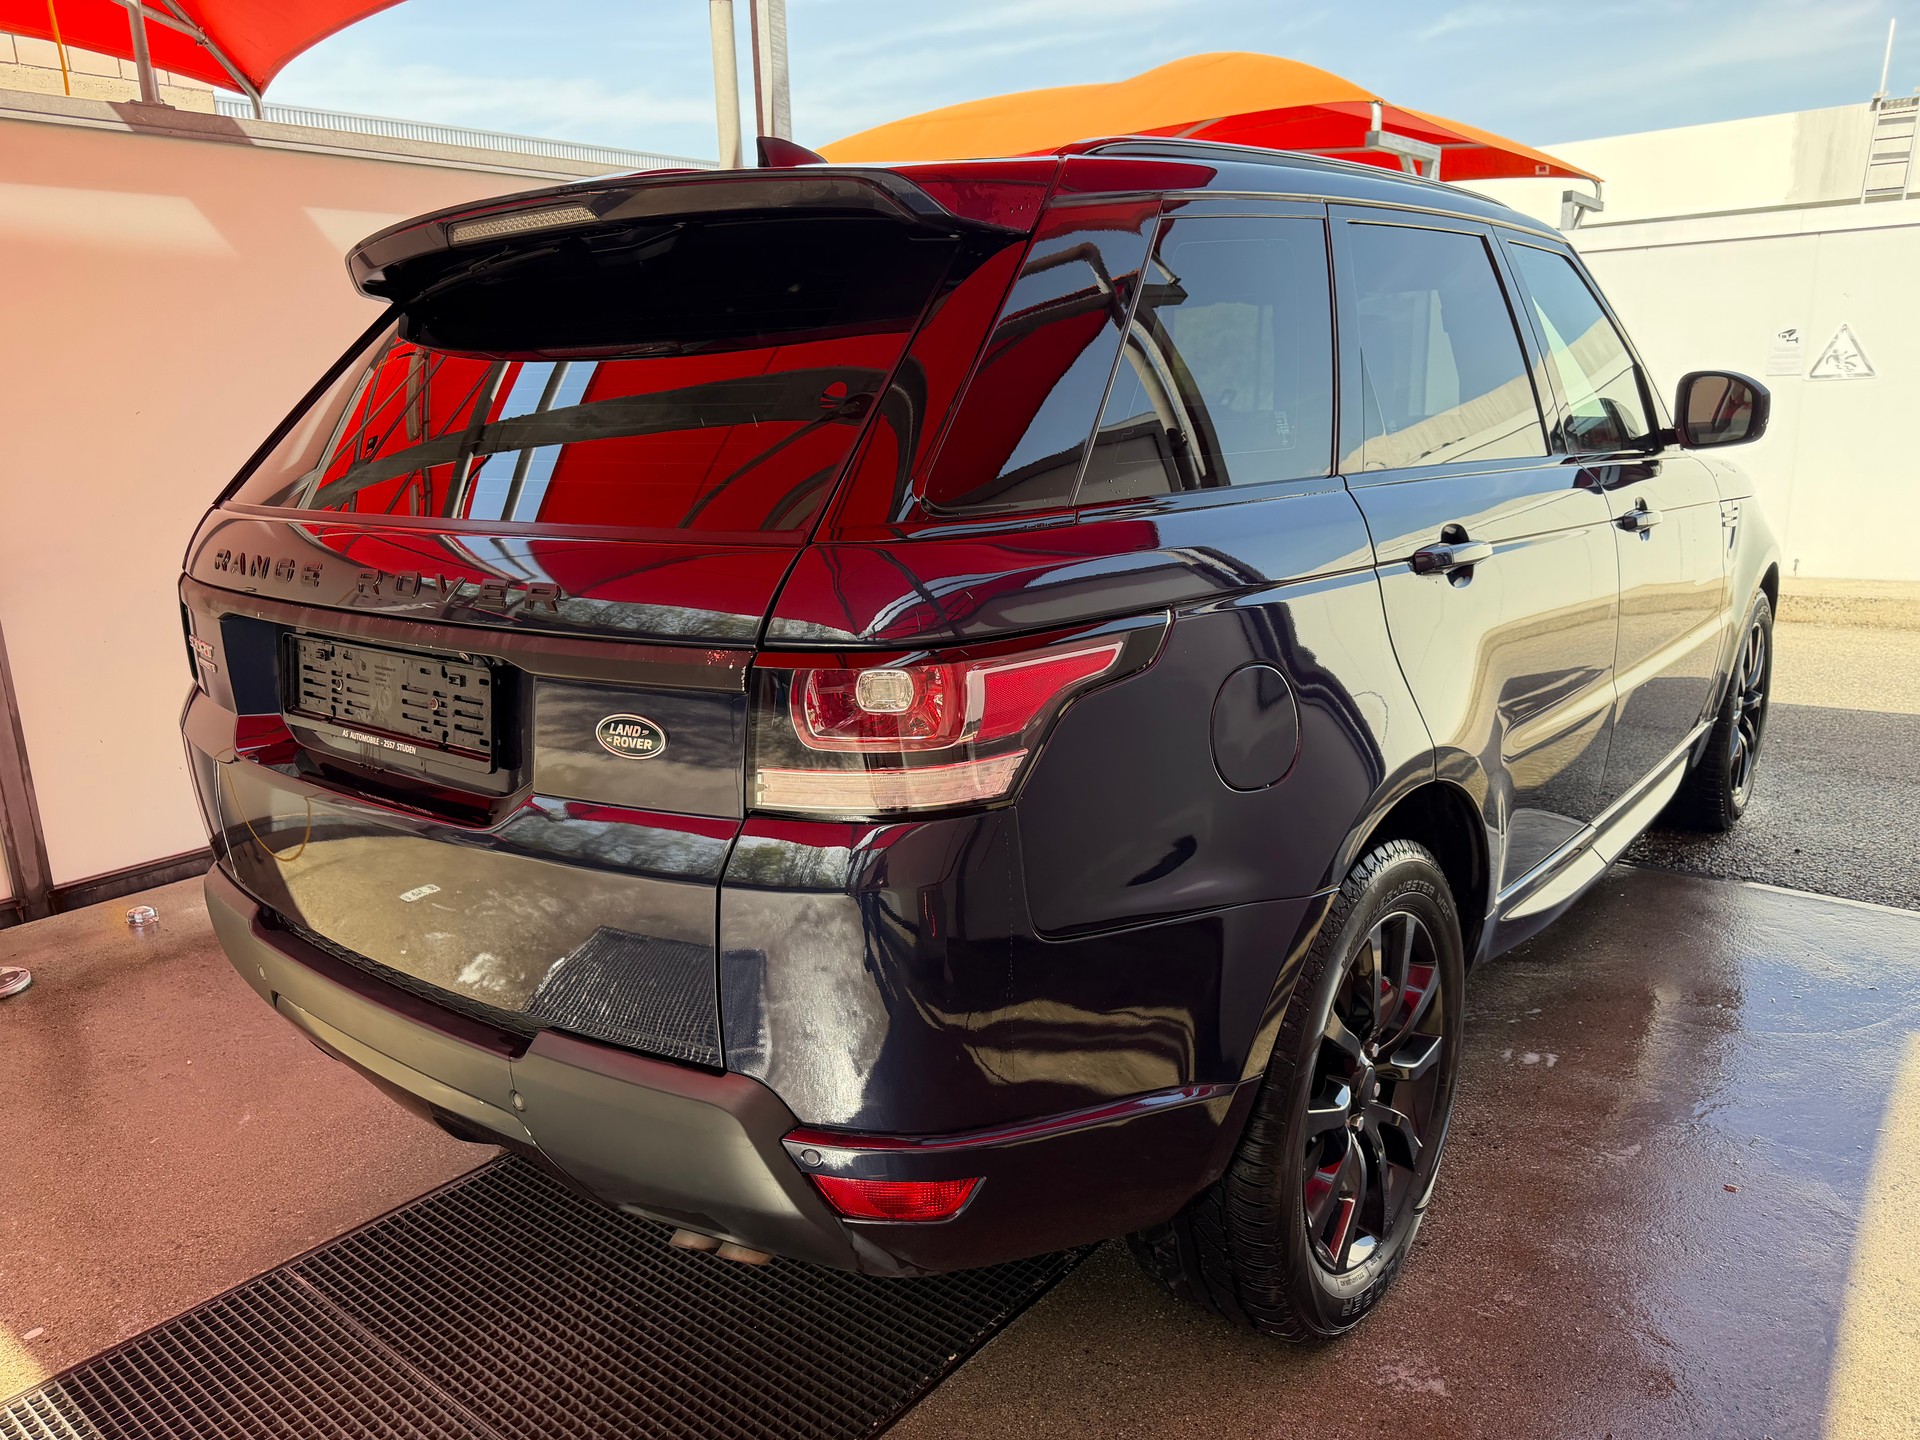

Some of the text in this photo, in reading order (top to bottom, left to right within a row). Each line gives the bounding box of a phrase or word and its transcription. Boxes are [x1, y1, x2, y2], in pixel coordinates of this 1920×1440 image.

[214, 549, 562, 613] RANGE ROVER
[609, 723, 641, 737] LAND
[350, 731, 380, 746] AUTOMOBILE
[383, 739, 396, 750] 2557
[396, 743, 416, 755] STUDEN
[613, 735, 653, 750] ROVER
